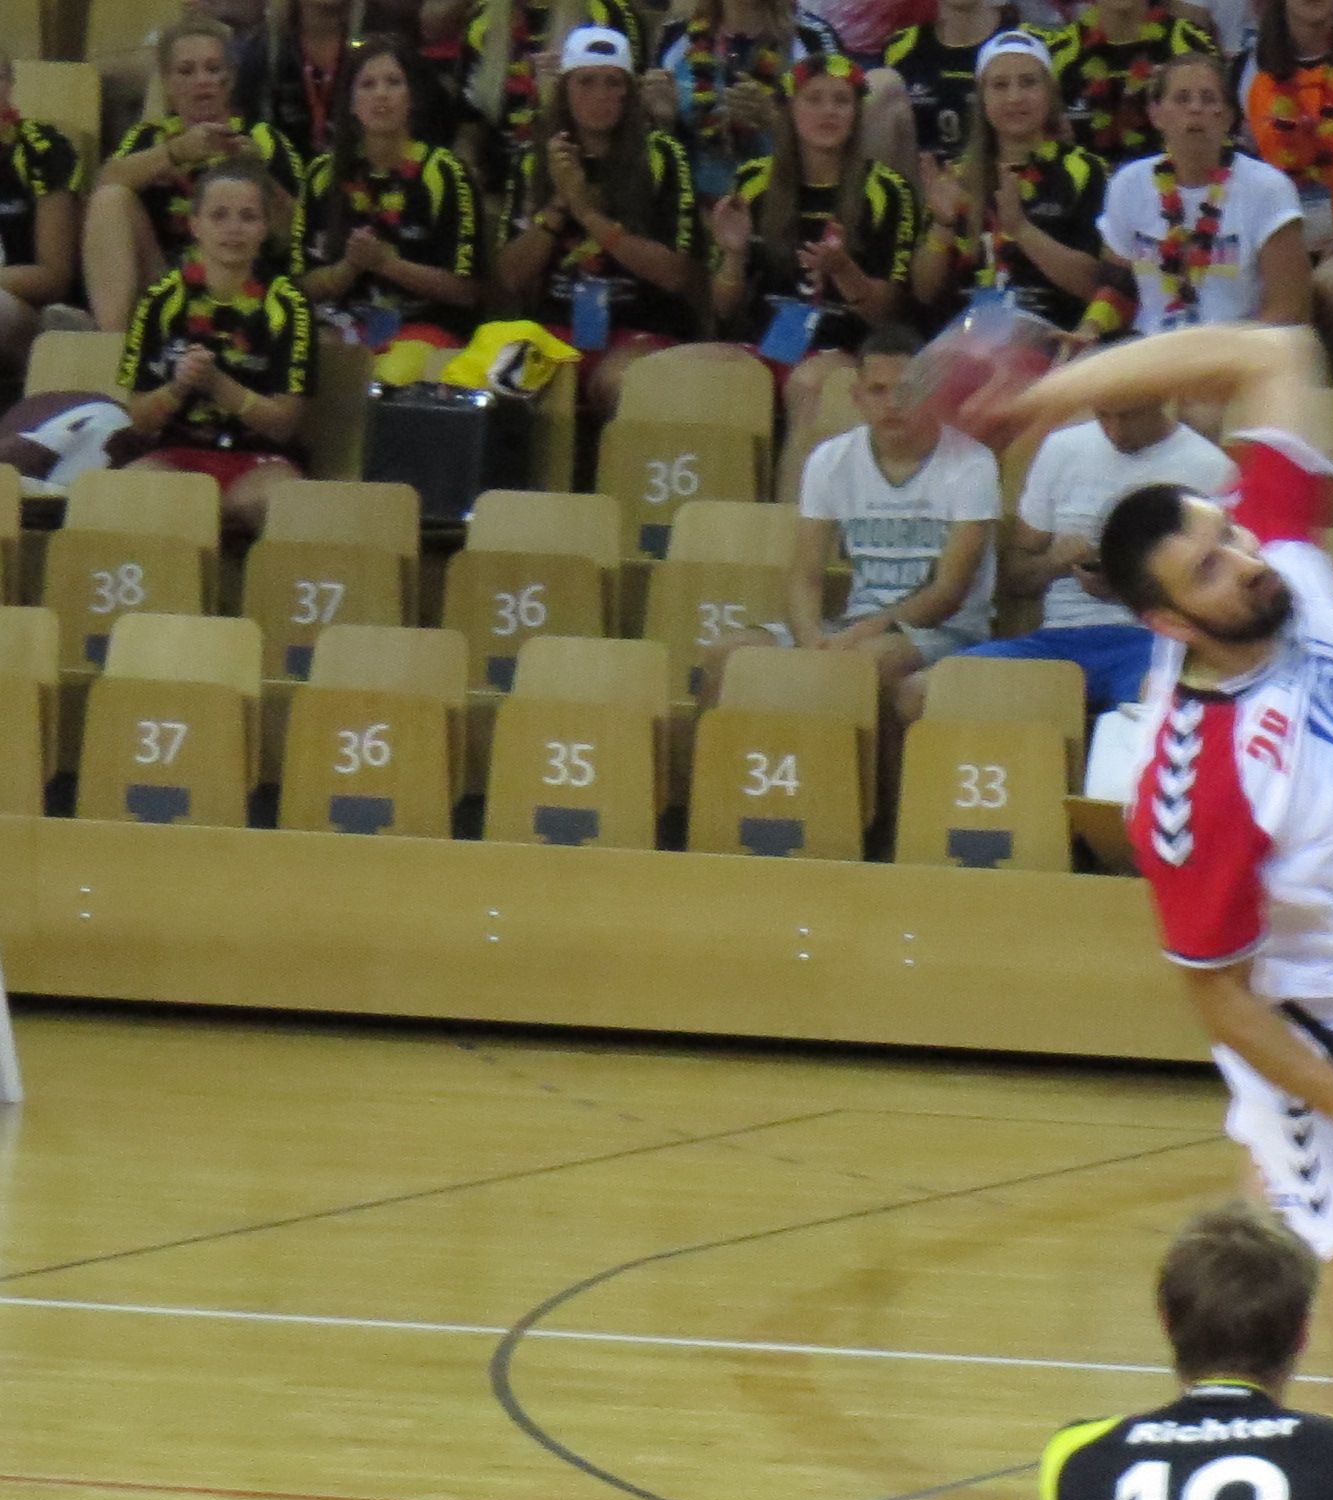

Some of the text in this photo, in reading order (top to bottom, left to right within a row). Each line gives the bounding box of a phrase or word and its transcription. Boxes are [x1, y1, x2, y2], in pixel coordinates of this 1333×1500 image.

[644, 453, 698, 503] 36
[89, 563, 145, 614] 38
[290, 581, 346, 625] 37
[493, 583, 548, 637] 36
[133, 720, 189, 764] 37
[333, 723, 391, 774] 36
[541, 741, 596, 787] 35
[743, 752, 799, 797] 34
[955, 764, 1008, 808] 33
[1124, 1416, 1302, 1445] Richter
